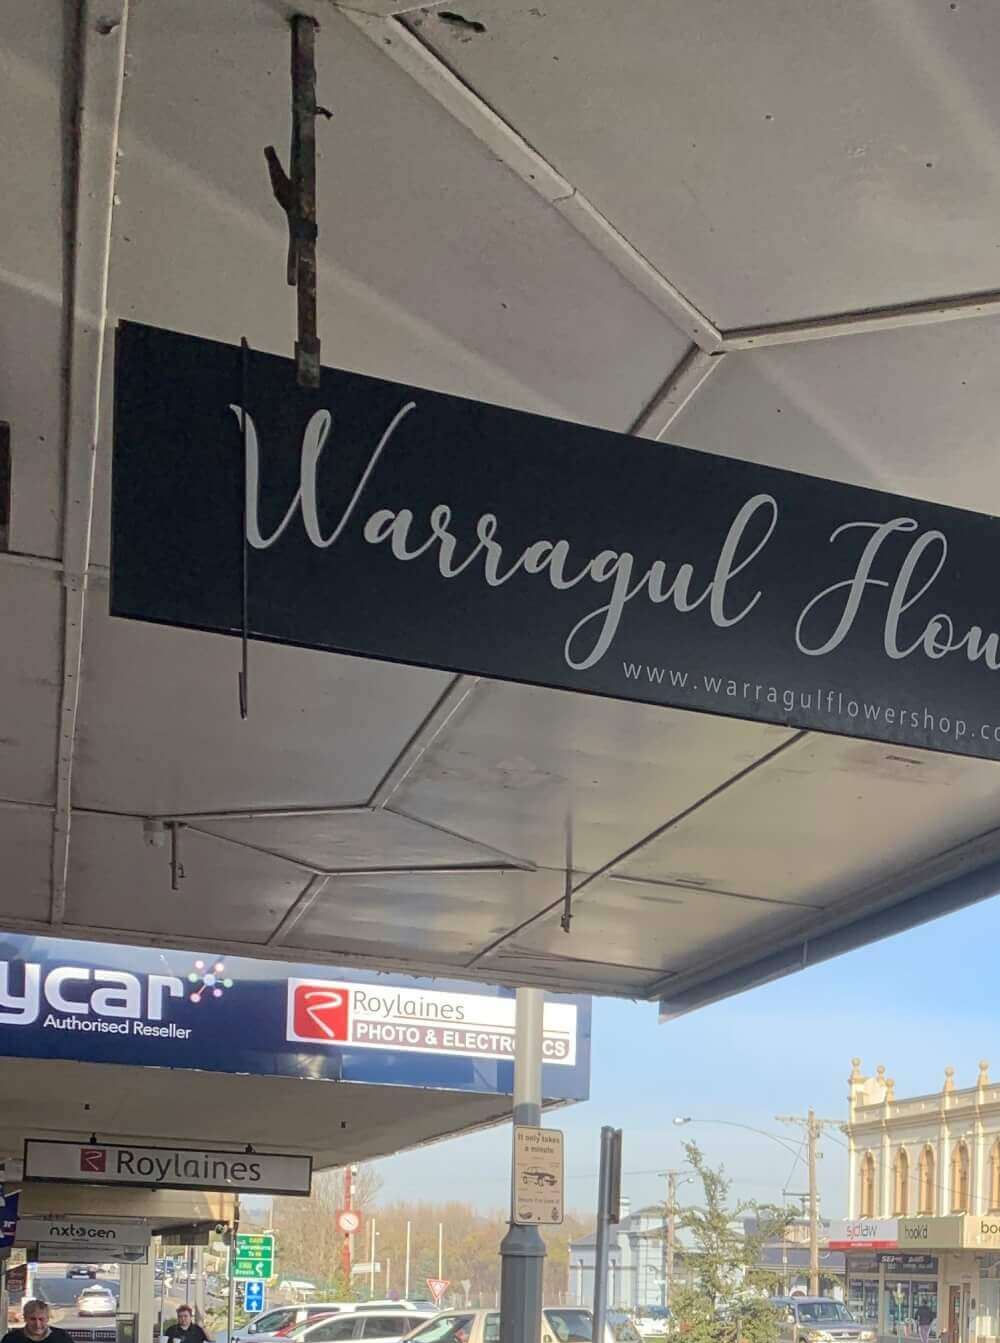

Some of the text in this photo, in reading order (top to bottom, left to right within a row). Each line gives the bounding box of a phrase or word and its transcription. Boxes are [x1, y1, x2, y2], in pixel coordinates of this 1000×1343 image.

[229, 401, 777, 671] Warragul
[353, 990, 465, 1020] Roylaines
[43, 1014, 192, 1040] Authorised Reseller
[356, 1022, 566, 1057] PHOTO & ELECTRCS
[117, 1150, 262, 1182] Roylaines
